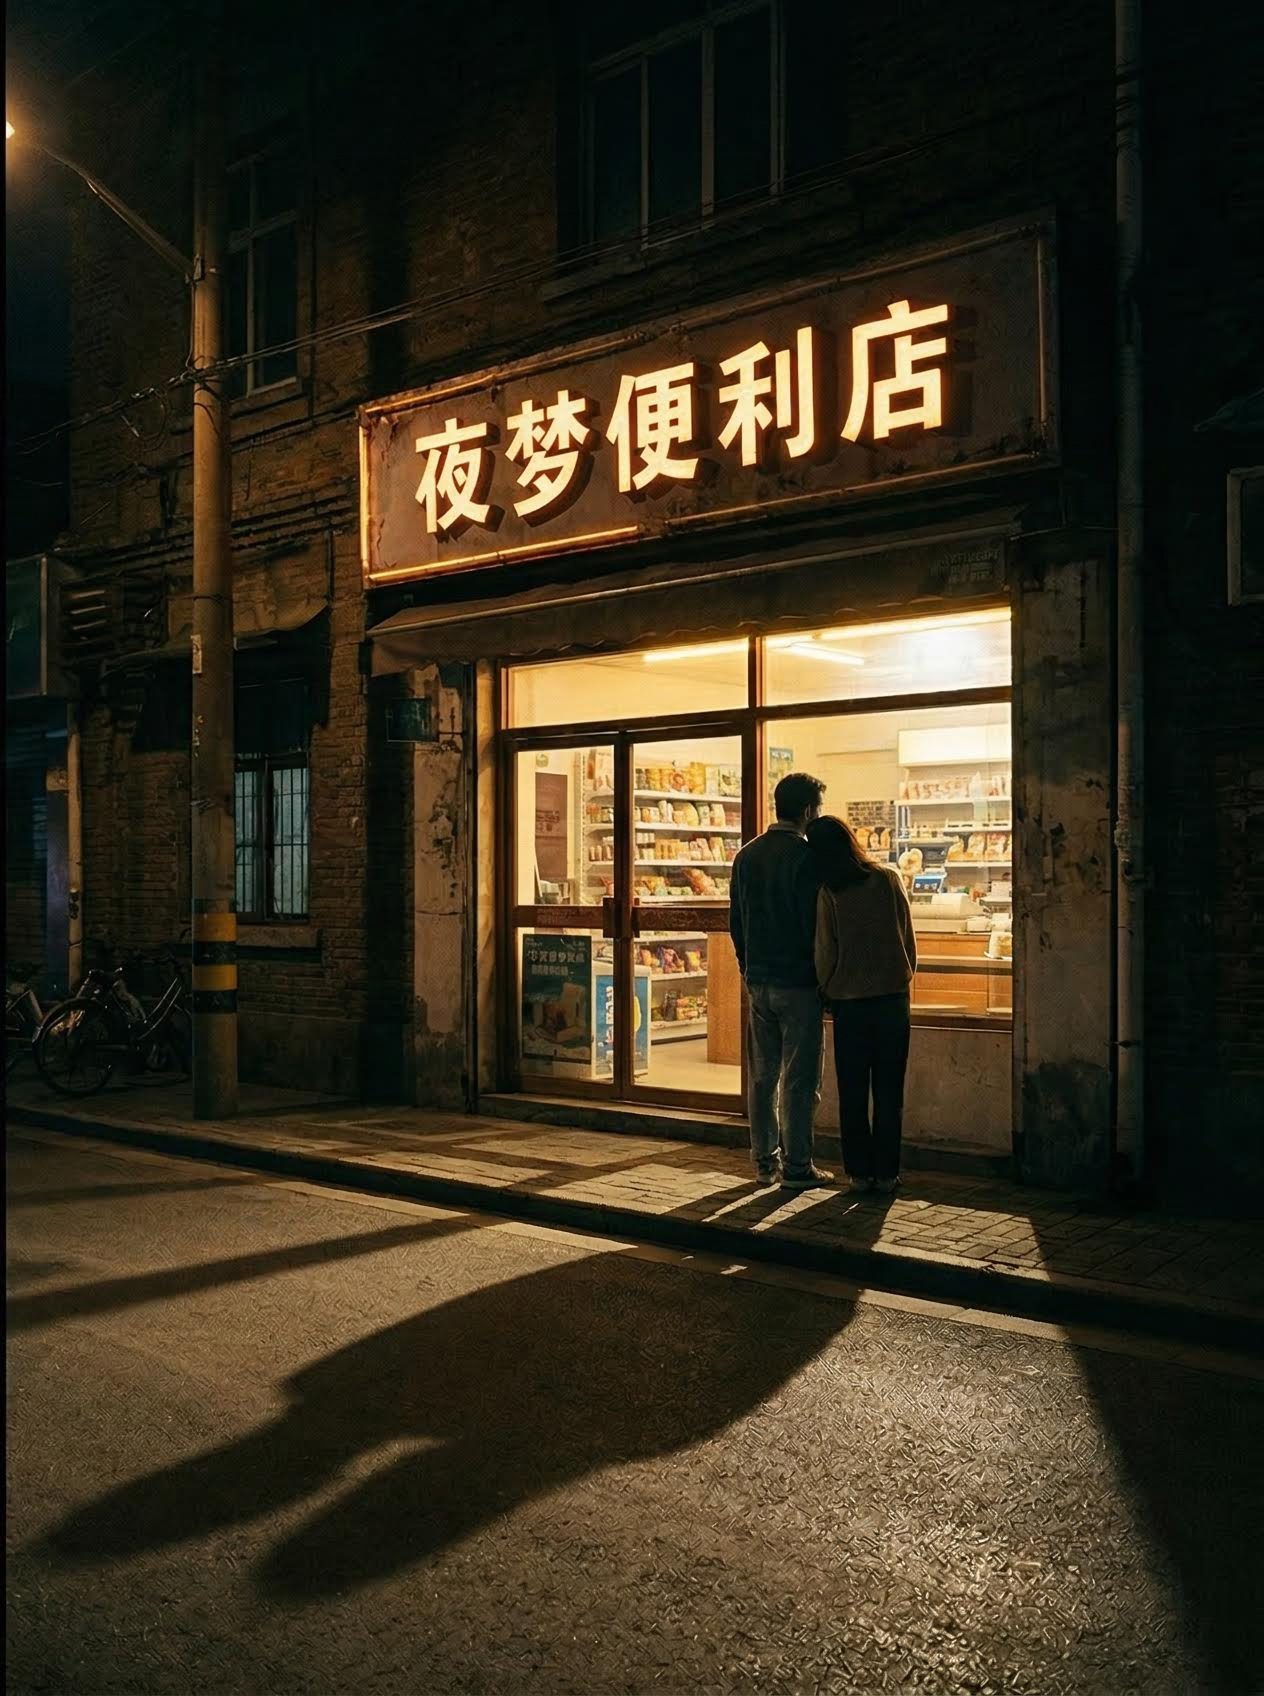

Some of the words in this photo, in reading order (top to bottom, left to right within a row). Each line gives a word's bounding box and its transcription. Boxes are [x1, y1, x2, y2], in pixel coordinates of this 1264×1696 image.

[414, 300, 949, 534] 夜梦便利店
